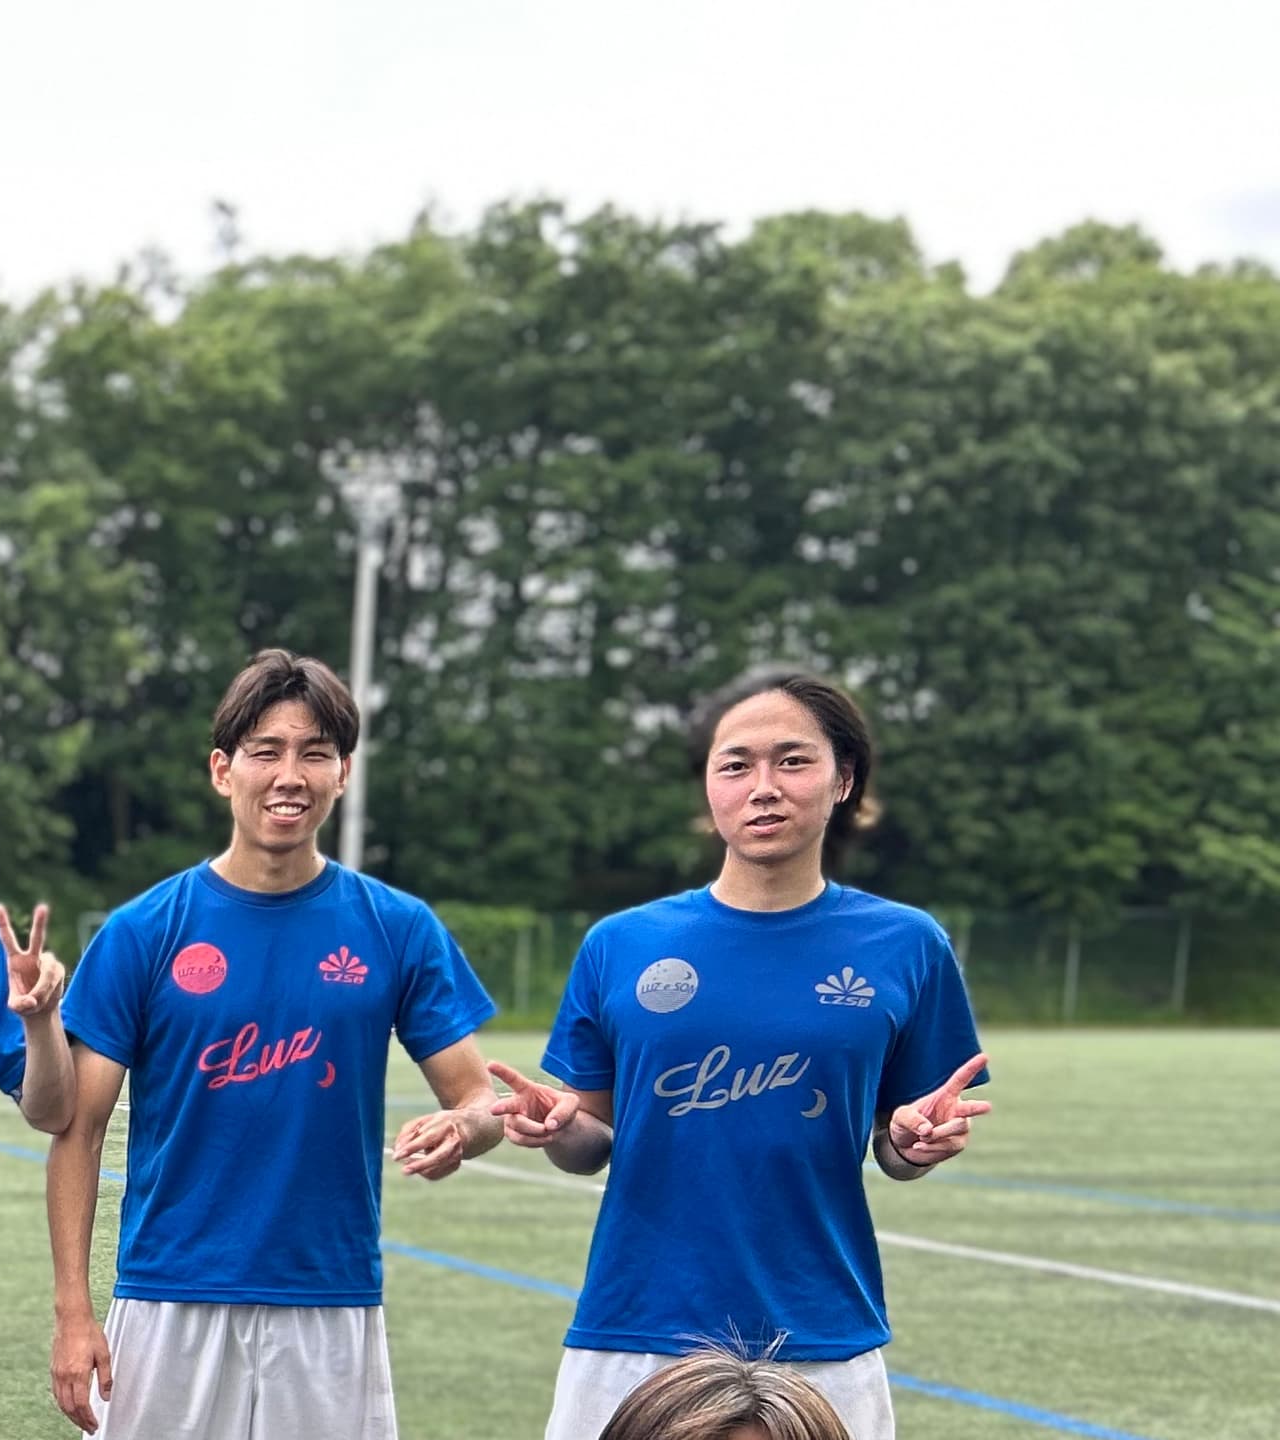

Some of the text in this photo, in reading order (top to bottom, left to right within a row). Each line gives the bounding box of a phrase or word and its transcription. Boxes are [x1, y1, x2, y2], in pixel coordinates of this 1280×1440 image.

[819, 995, 871, 1008] LZSB
[197, 1022, 322, 1089] Luz
[653, 1045, 811, 1117] Luz
